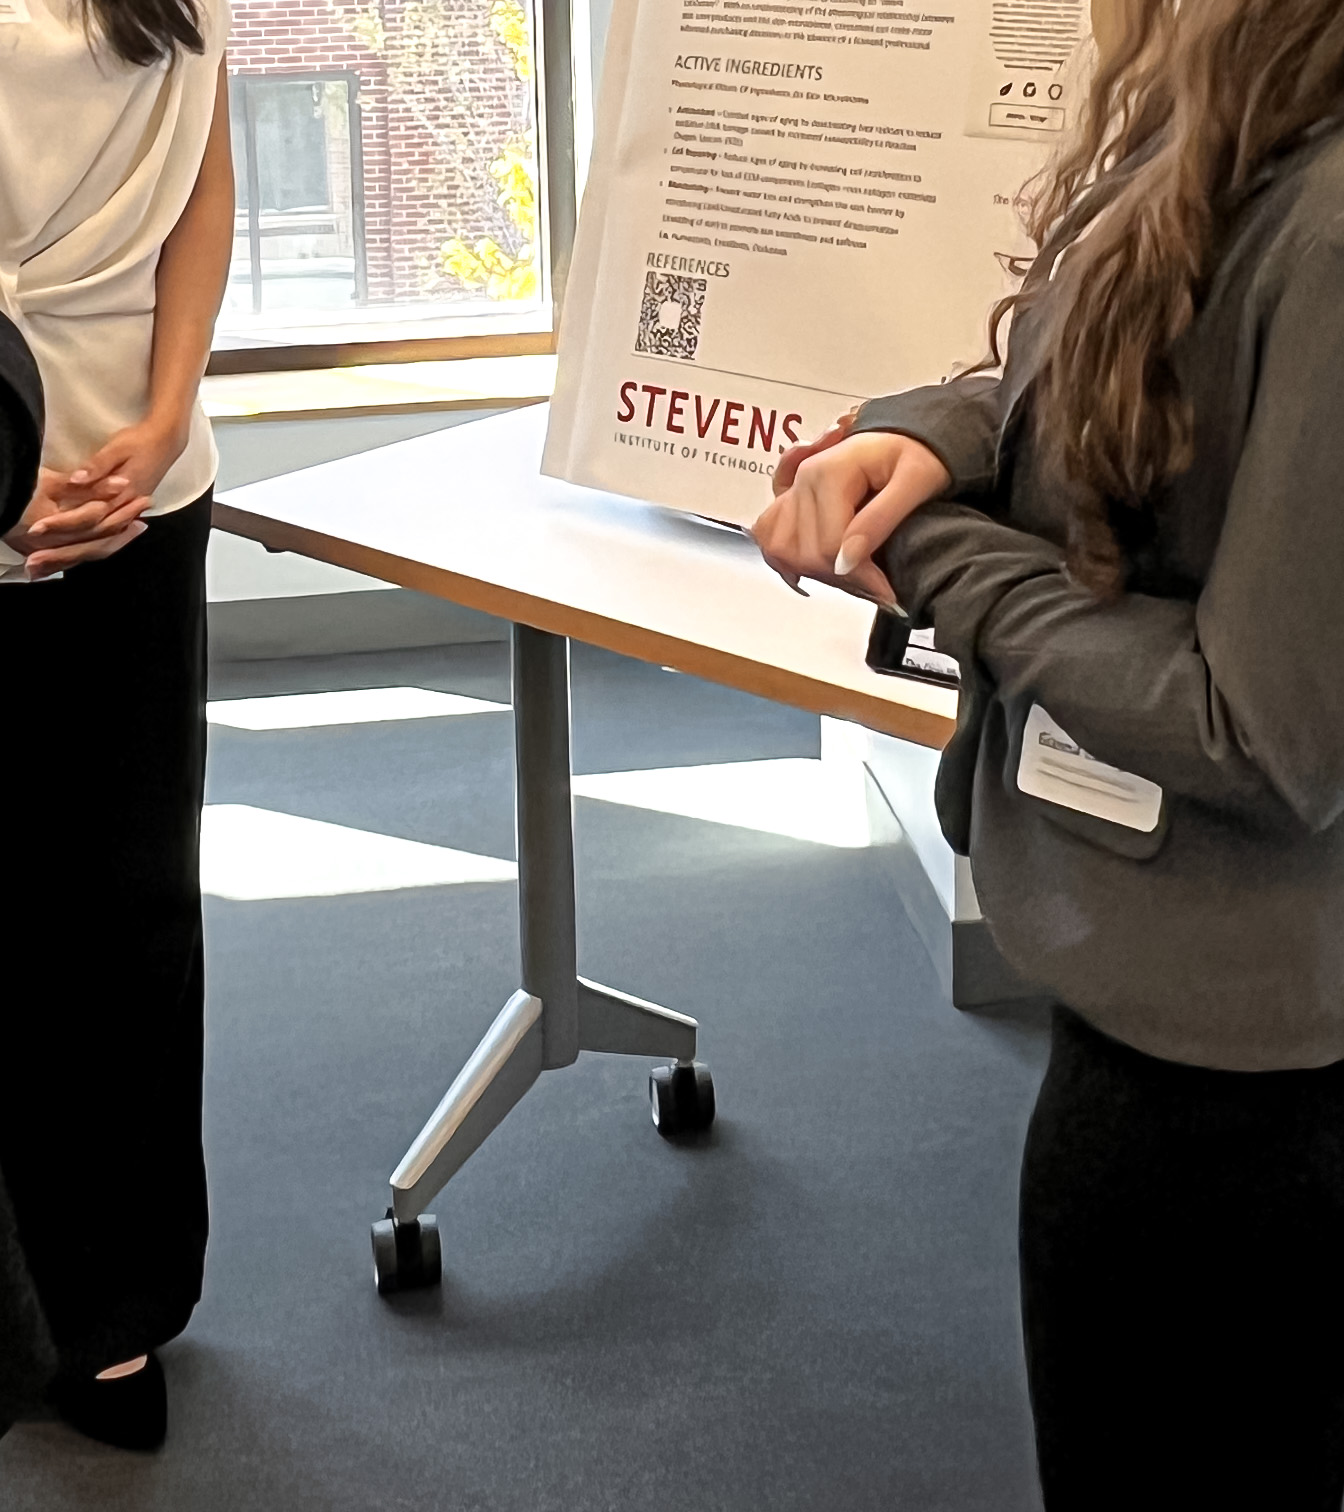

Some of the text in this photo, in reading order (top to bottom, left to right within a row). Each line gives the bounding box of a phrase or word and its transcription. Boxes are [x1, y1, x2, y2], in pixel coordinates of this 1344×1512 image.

[674, 54, 825, 82] ACTIVE INGREDIENTS
[645, 252, 731, 279] REFERENCES
[616, 380, 804, 455] STEVENS
[613, 431, 676, 456] INSTITUTE
